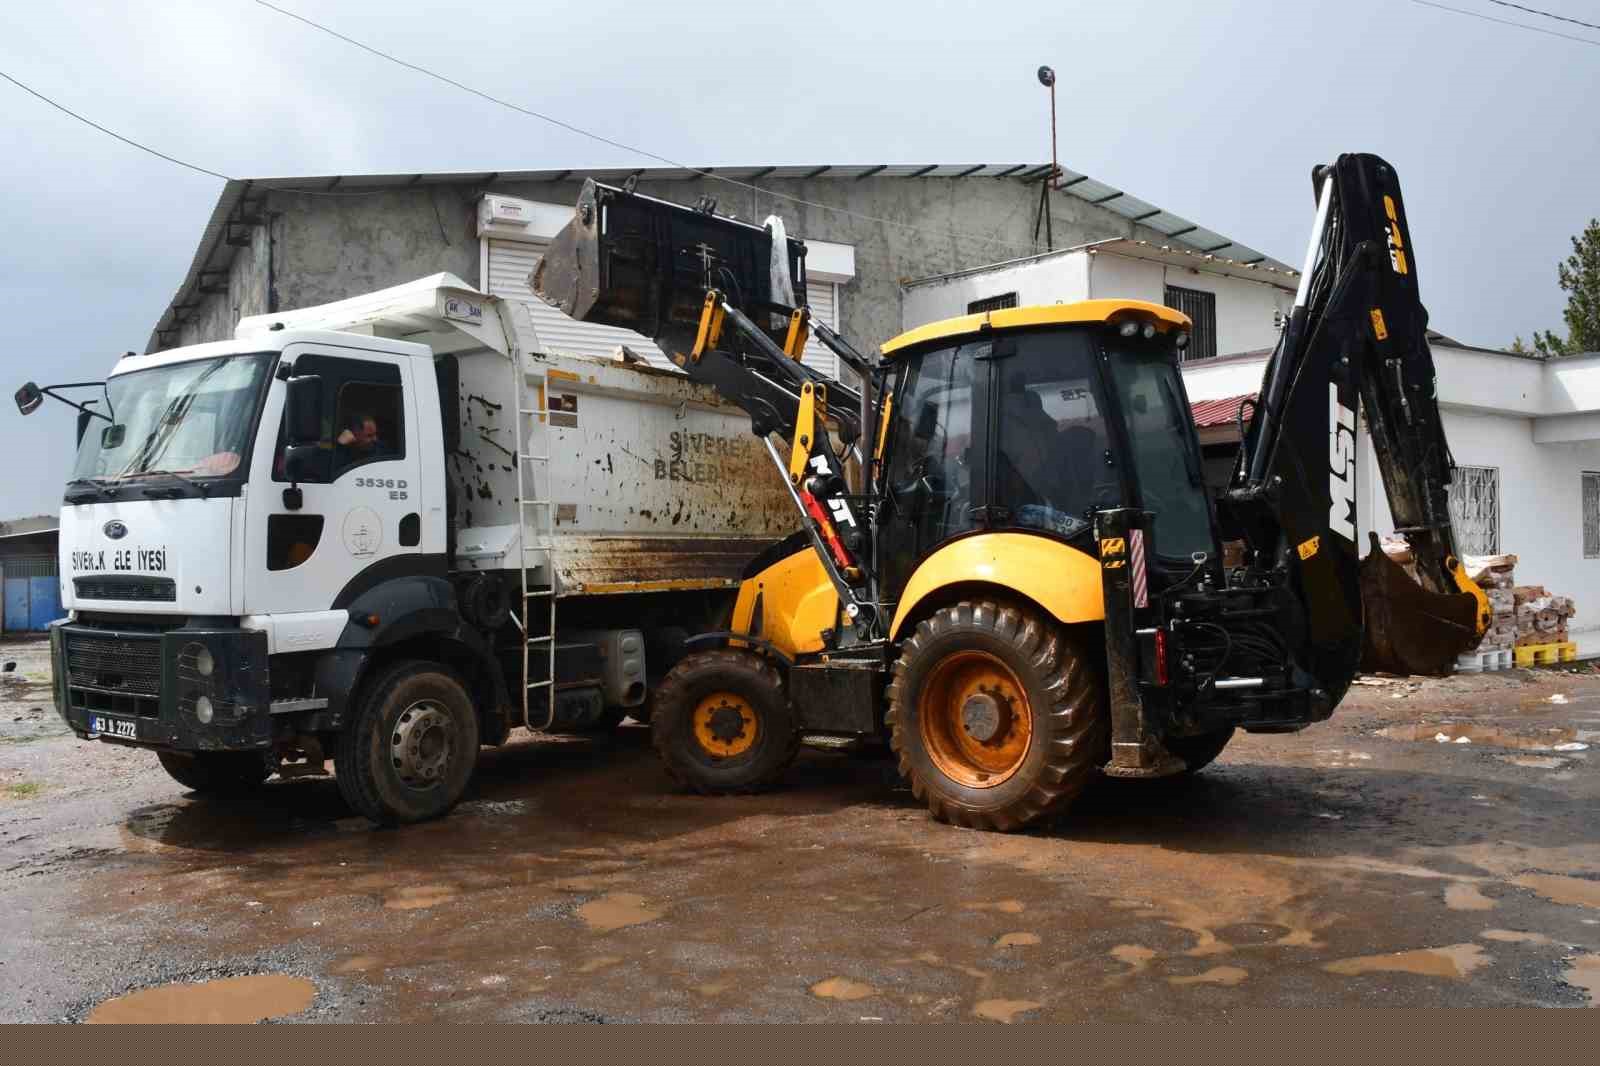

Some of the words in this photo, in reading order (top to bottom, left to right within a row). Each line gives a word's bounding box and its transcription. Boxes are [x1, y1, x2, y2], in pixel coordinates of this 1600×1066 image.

[1329, 381, 1355, 542] MST
[355, 478, 395, 489] 3536
[397, 479, 408, 489] D
[389, 490, 408, 500] E5
